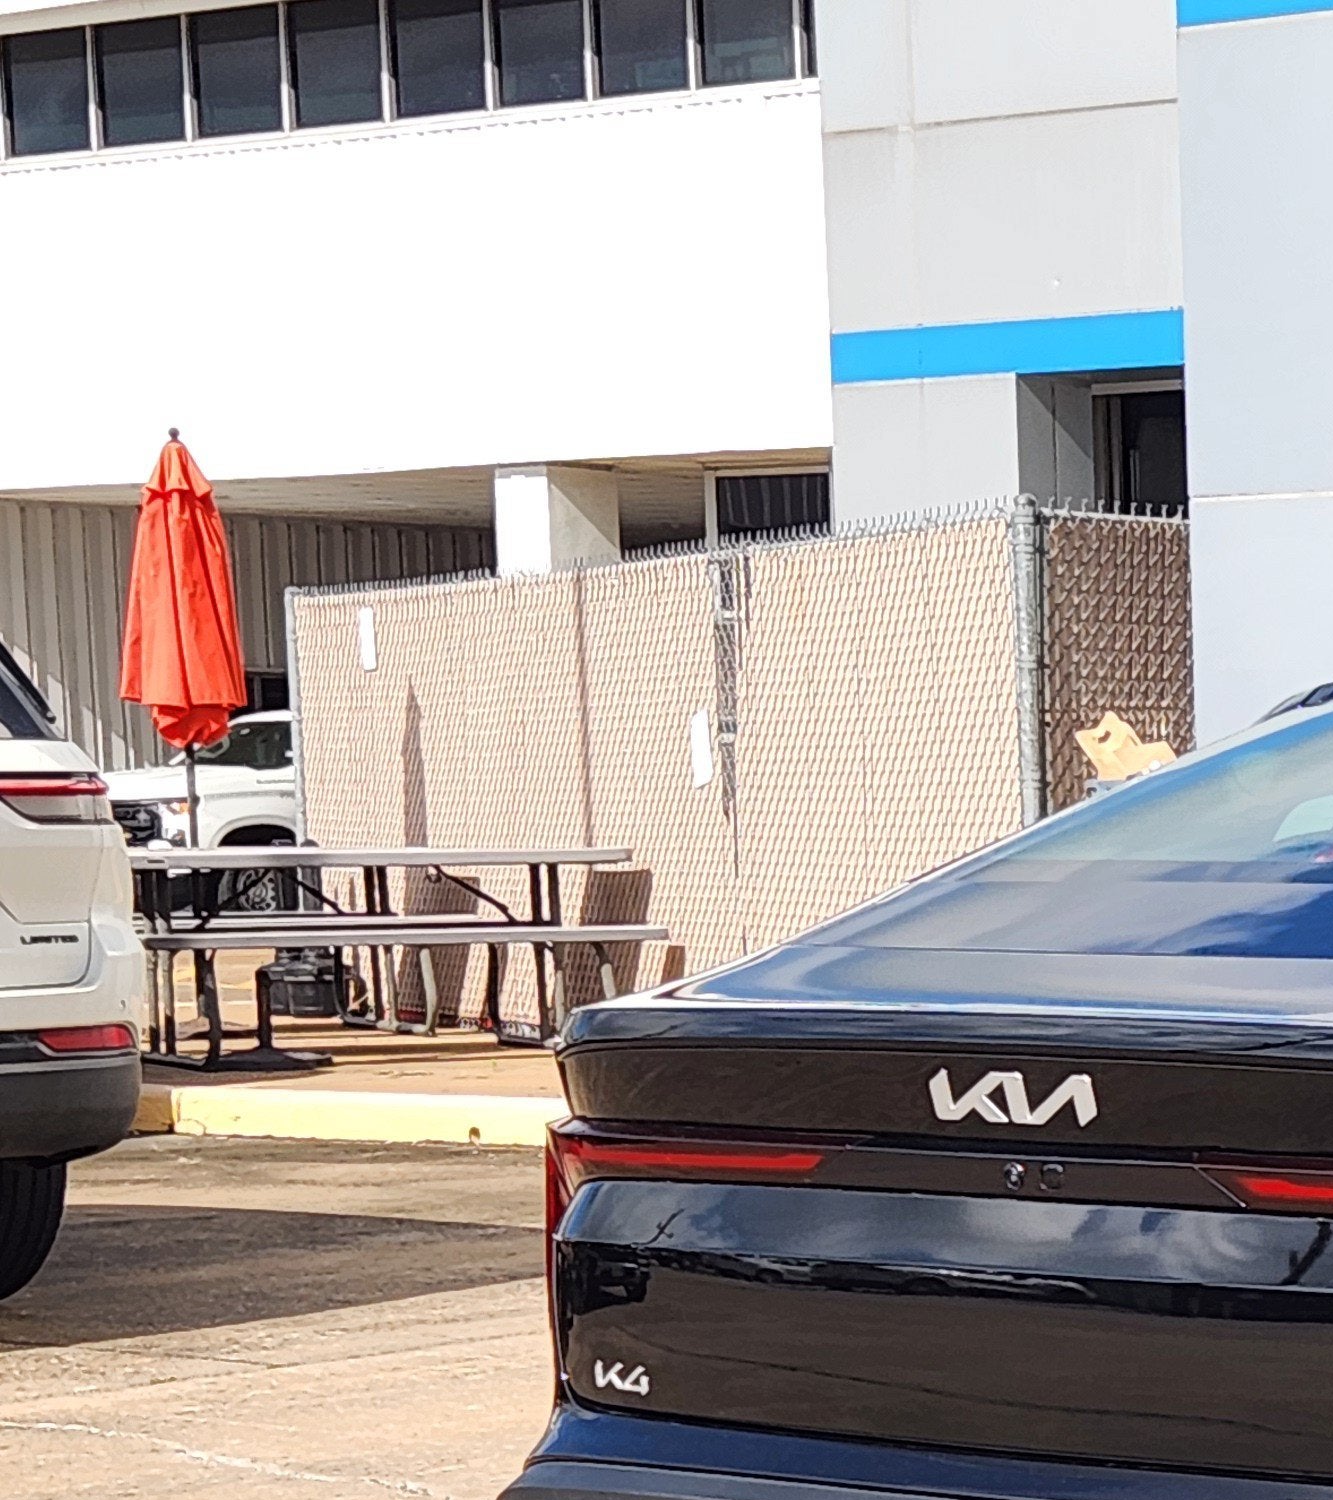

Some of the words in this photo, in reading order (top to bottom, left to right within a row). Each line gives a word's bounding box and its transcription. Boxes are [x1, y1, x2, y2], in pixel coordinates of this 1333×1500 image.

[20, 934, 80, 946] LIMITED
[929, 1067, 1098, 1128] KIA
[594, 1359, 649, 1396] K4
